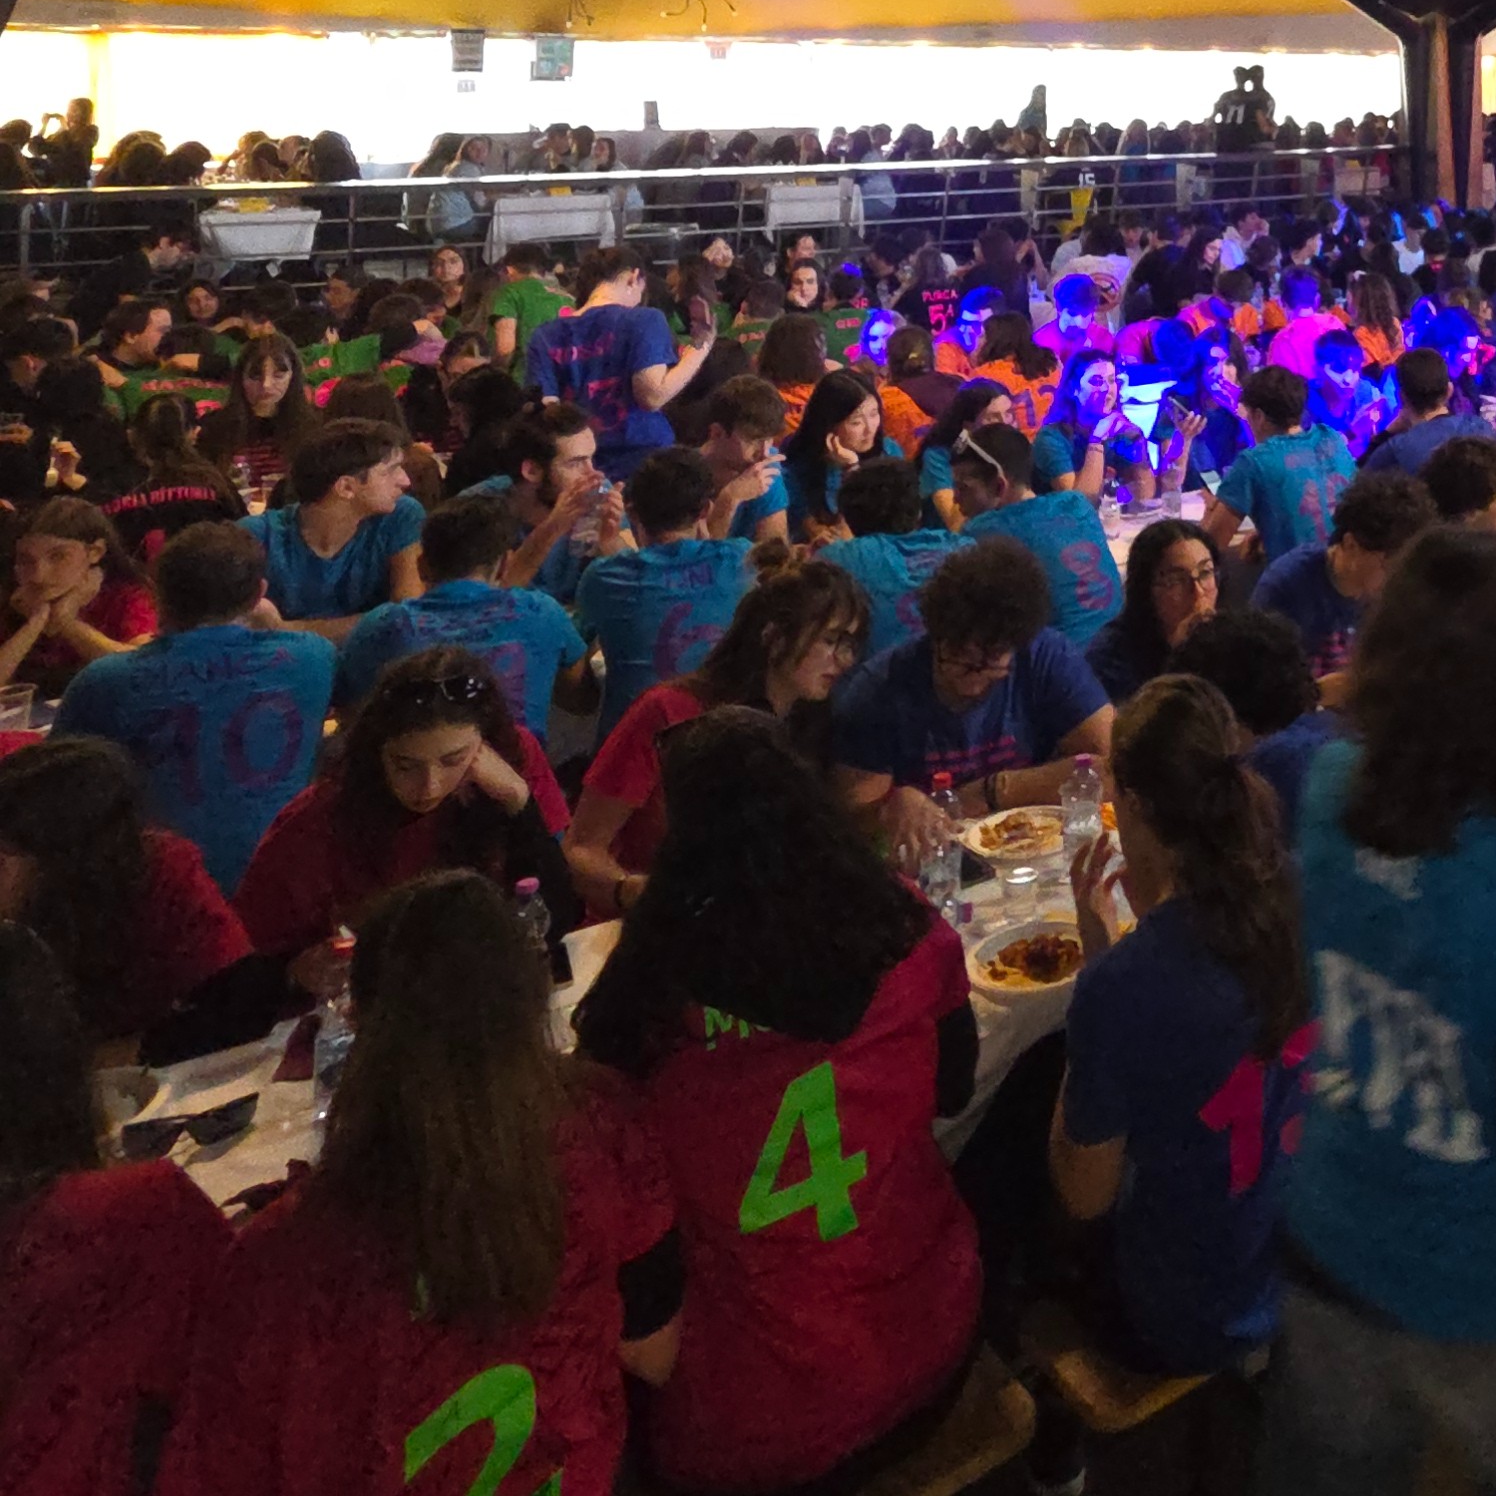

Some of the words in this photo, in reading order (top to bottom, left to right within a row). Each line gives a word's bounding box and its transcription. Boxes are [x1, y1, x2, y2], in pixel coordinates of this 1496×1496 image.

[1059, 540, 1114, 611] 8
[140, 689, 304, 805] 10
[738, 1060, 868, 1243] 4
